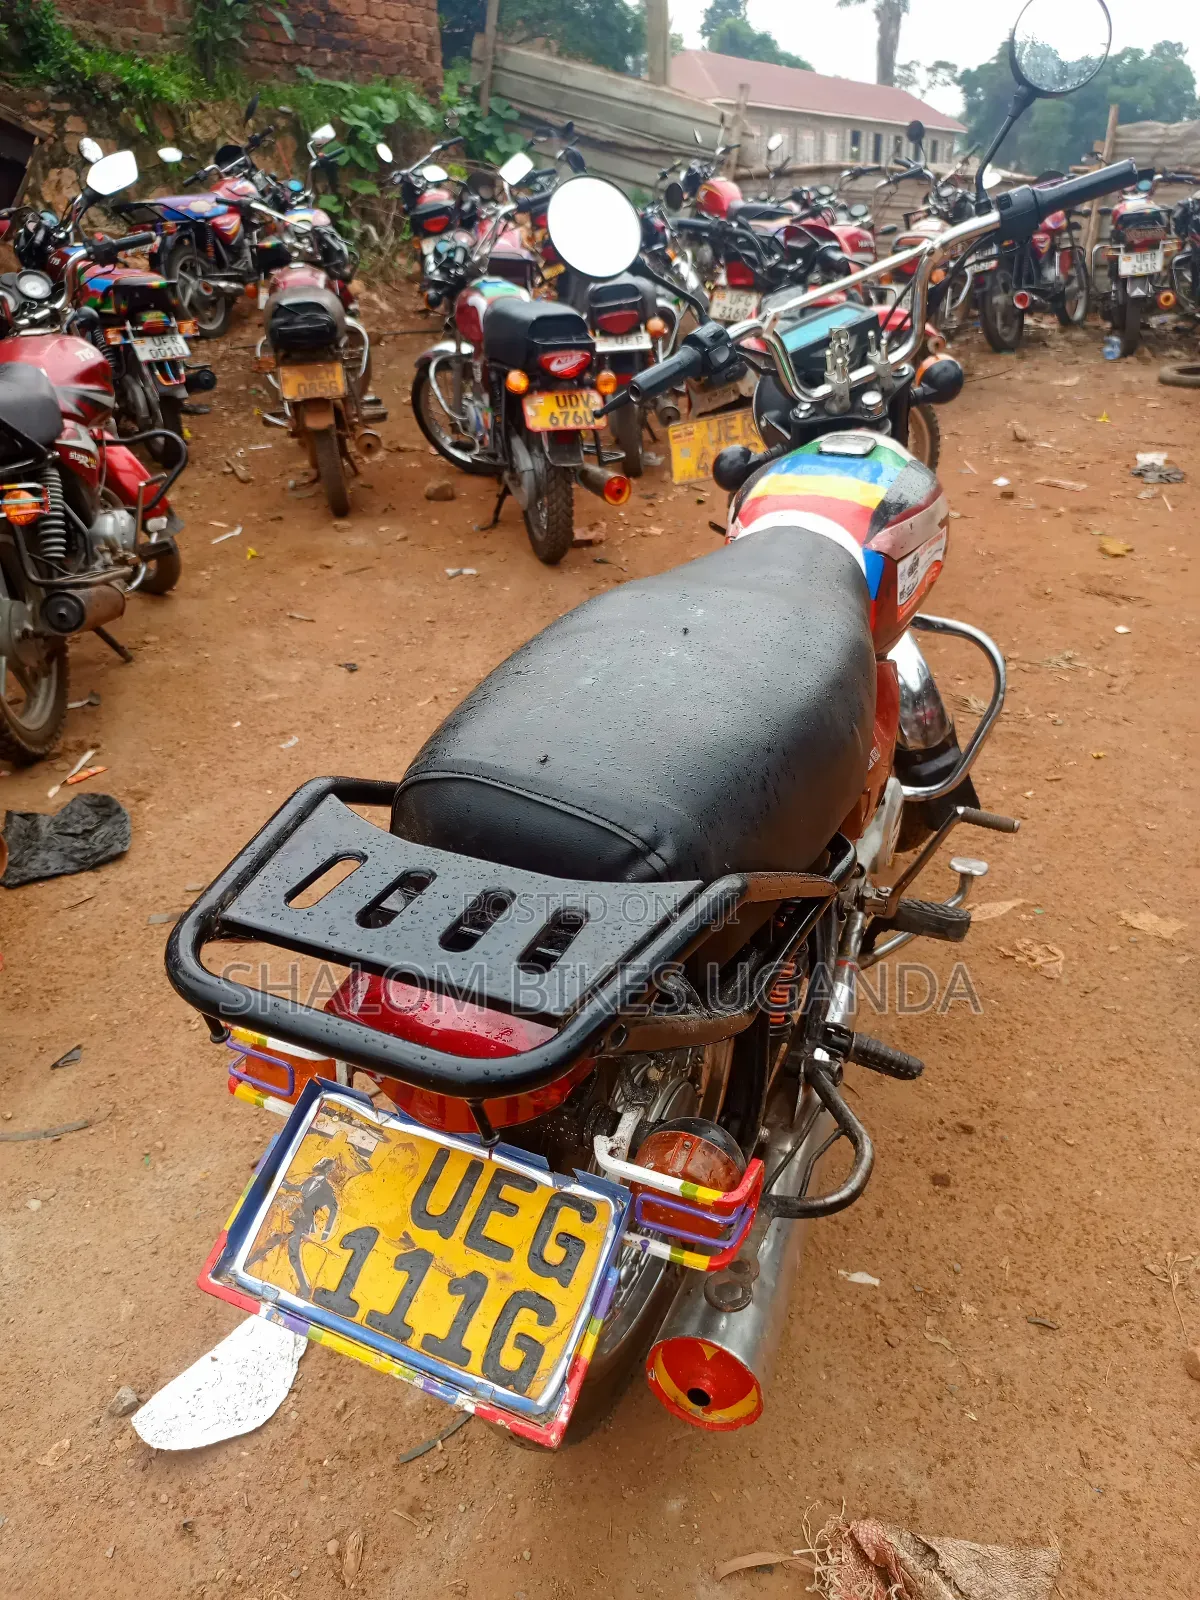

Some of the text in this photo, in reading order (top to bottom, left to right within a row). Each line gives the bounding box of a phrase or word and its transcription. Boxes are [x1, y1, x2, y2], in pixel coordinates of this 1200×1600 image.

[549, 410, 595, 427] 676U
[555, 393, 592, 409] UDV
[410, 1147, 598, 1288] UEG
[312, 1225, 557, 1395] 111G
